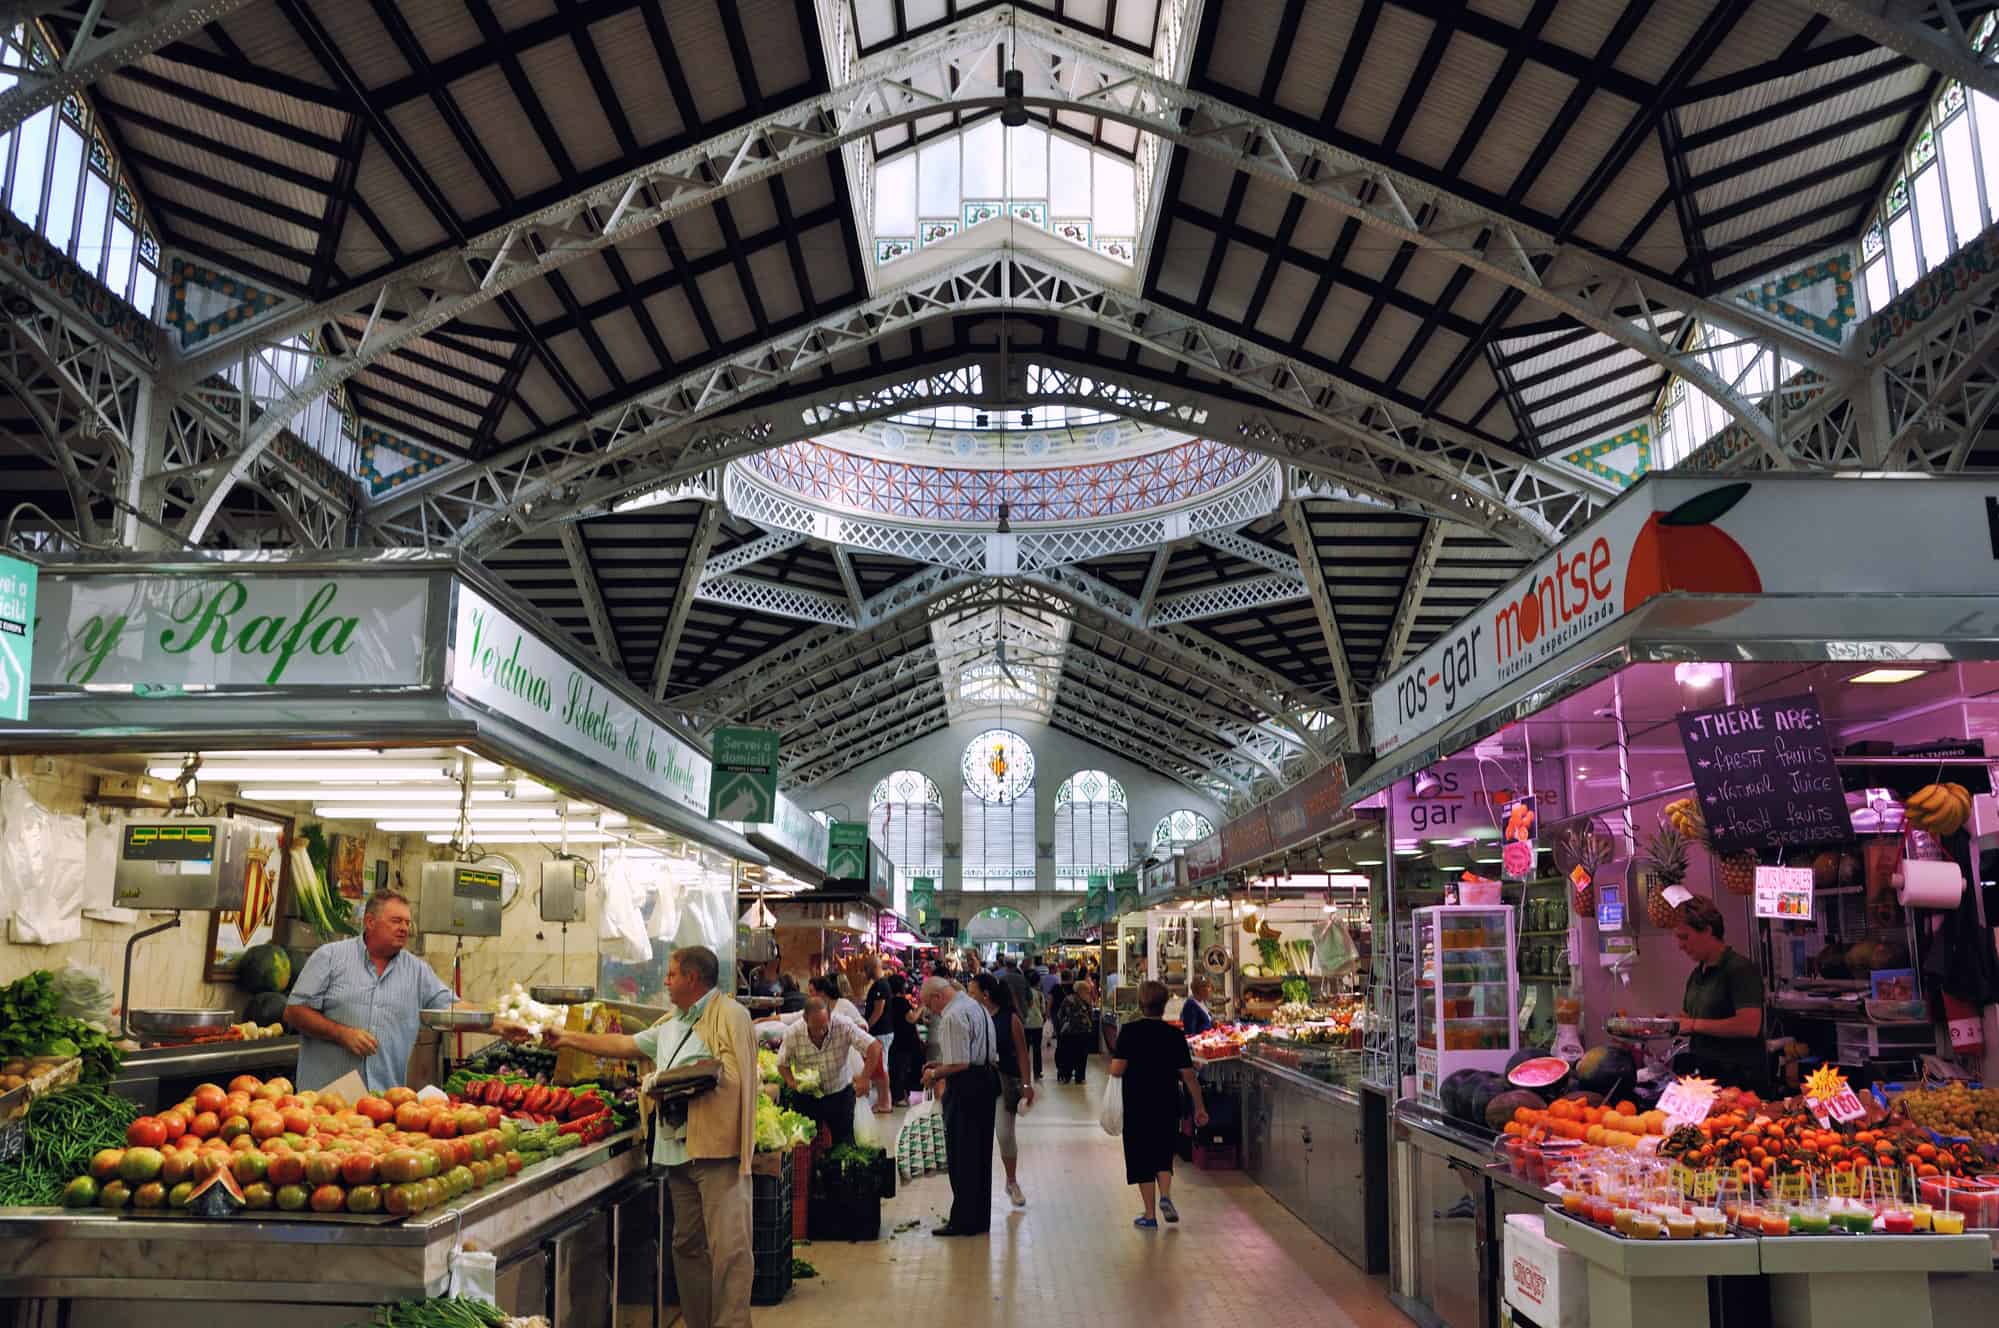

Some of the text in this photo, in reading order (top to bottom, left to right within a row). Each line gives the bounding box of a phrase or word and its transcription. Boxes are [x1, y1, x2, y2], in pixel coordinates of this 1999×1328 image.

[65, 578, 360, 687] y Rafa
[1495, 537, 1612, 664] montse
[1540, 600, 1614, 656] especializada
[471, 607, 552, 713] Verduras
[562, 671, 617, 752] Selectas
[625, 716, 639, 763] de
[645, 728, 657, 773] la
[1397, 625, 1481, 726] ros-gar
[1694, 707, 1765, 739] THERE
[1410, 802, 1462, 832] gar
